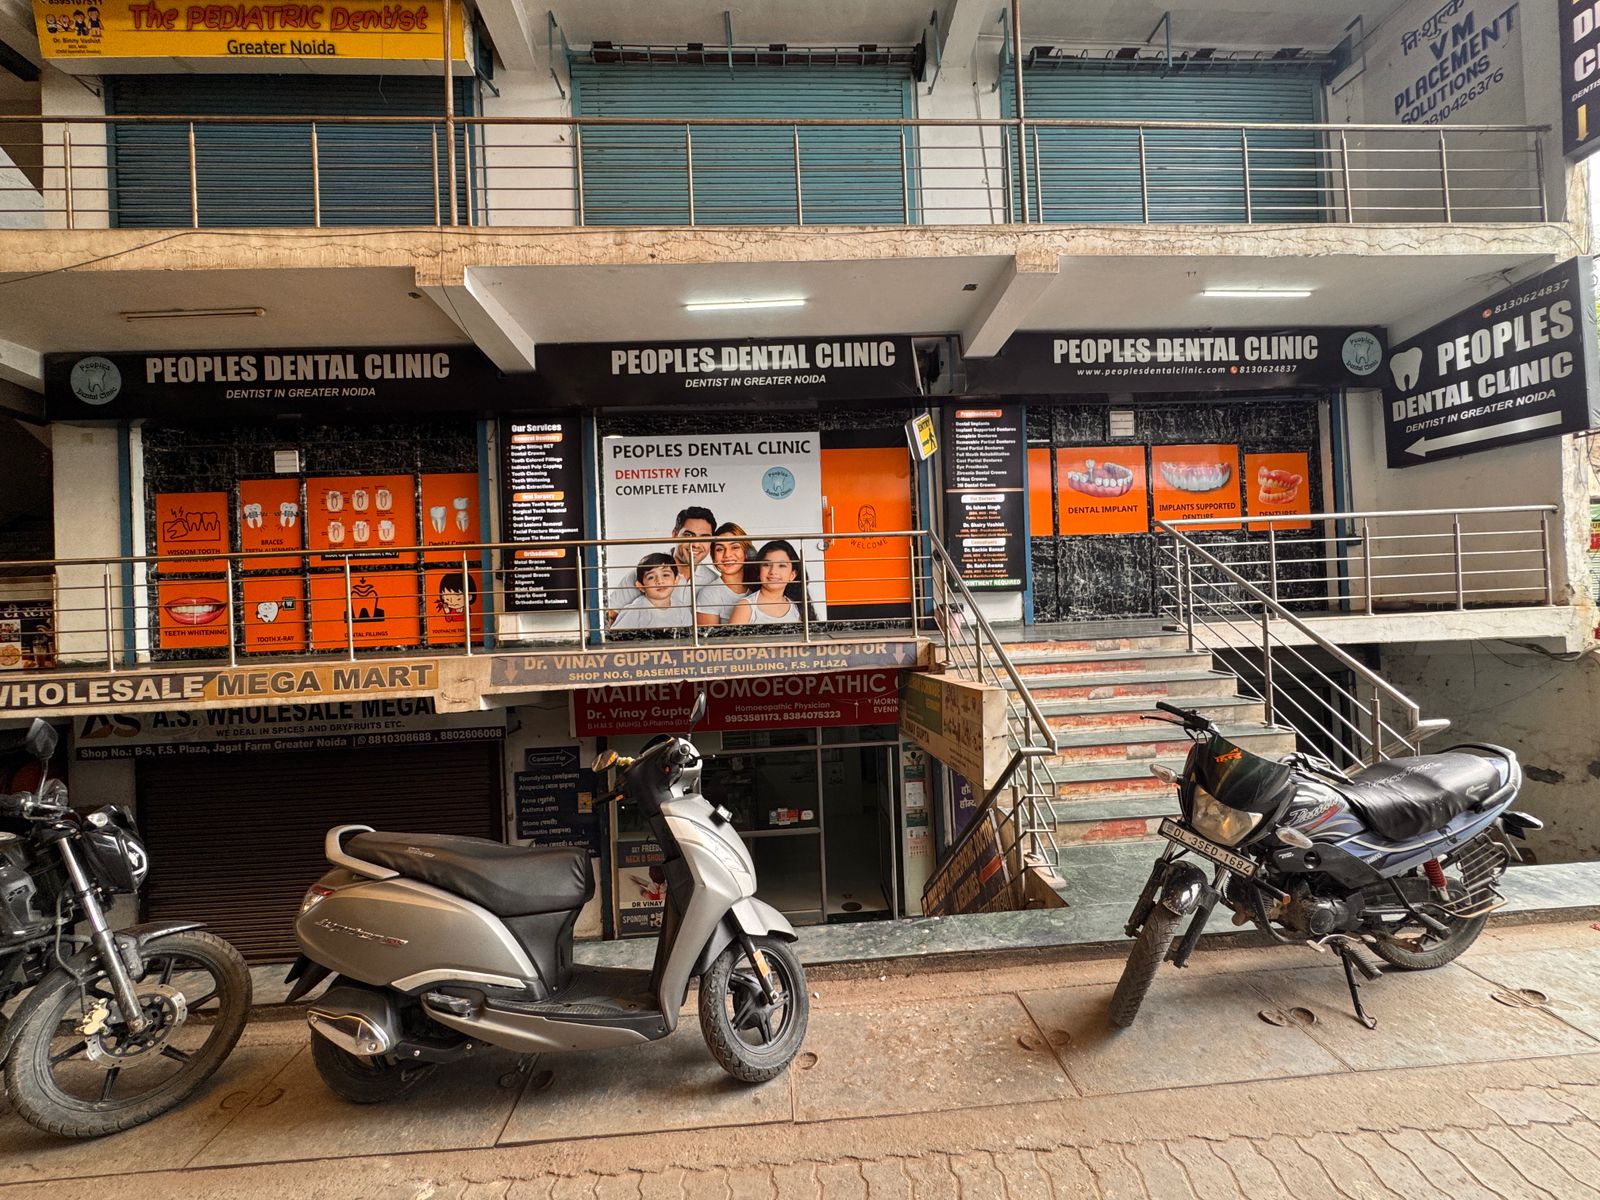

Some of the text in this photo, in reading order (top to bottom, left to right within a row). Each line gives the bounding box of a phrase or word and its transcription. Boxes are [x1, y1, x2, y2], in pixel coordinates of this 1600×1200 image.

[128, 4, 428, 31] The PEDIATRIC Dentist
[227, 39, 336, 56] Greater Noida
[1394, 2, 1520, 116] PLACEMENT
[1401, 54, 1491, 124] SOLUTIONS
[1423, 67, 1504, 125] 810426376
[1494, 278, 1570, 314] 8130624837
[1053, 335, 1318, 364] PEOPLES DENTAL CLINIC
[1437, 300, 1574, 376] PEOPLES
[79, 362, 110, 372] Peoples
[146, 352, 450, 384] PEOPLES DENTAL CLINIC
[611, 341, 896, 375] PEOPLES DENTAL CLINIC
[685, 374, 826, 388] DENTIST IN GREATER NOIDA
[1077, 364, 1297, 376] www.peoplesdentalclinic.com 8130624837
[226, 386, 376, 400] DENTIST IN GREATER NOIDA
[1392, 351, 1574, 422] DENTAL CLINIC
[1405, 388, 1556, 434] DENTIST IN GREATER NOIDA
[512, 424, 562, 432] Our Services
[612, 440, 812, 459] PEOPLES DENTAL CLINIC
[615, 468, 708, 480] DENTISTRY FOR
[615, 482, 726, 496] COMPLETE FAMILY
[1068, 504, 1138, 514] DENTAL IMPLANT
[1196, 502, 1236, 510] SUPPORTED
[850, 537, 888, 550] WELCOME
[184, 628, 228, 637] WHITENING
[524, 642, 888, 670] Dr. VINAY GUPTA, HOMEOPATHIC DOCTOR
[215, 668, 322, 698] MEGA
[332, 663, 434, 690] MART
[568, 658, 848, 682] SHOP NO.6, BASEMENT, LEFT BUILDING, F.S. PLAZA
[693, 674, 887, 701] HOMOEOPATHIC
[207, 702, 354, 726] WHOLESALE
[586, 704, 692, 722] Dr. Vinay Gupta
[735, 700, 831, 714] Homoeopathic Physician
[233, 728, 256, 736] DEAL
[259, 728, 270, 736] IN
[271, 726, 305, 735] SPICES
[308, 724, 328, 732] AND
[330, 722, 382, 731] DRYFRUITS
[81, 737, 347, 760] Shop No.: B-5, F.S. Plaza, Jagat Farm Greater Noida
[1174, 828, 1186, 841] DL
[1190, 836, 1219, 856] 3SED
